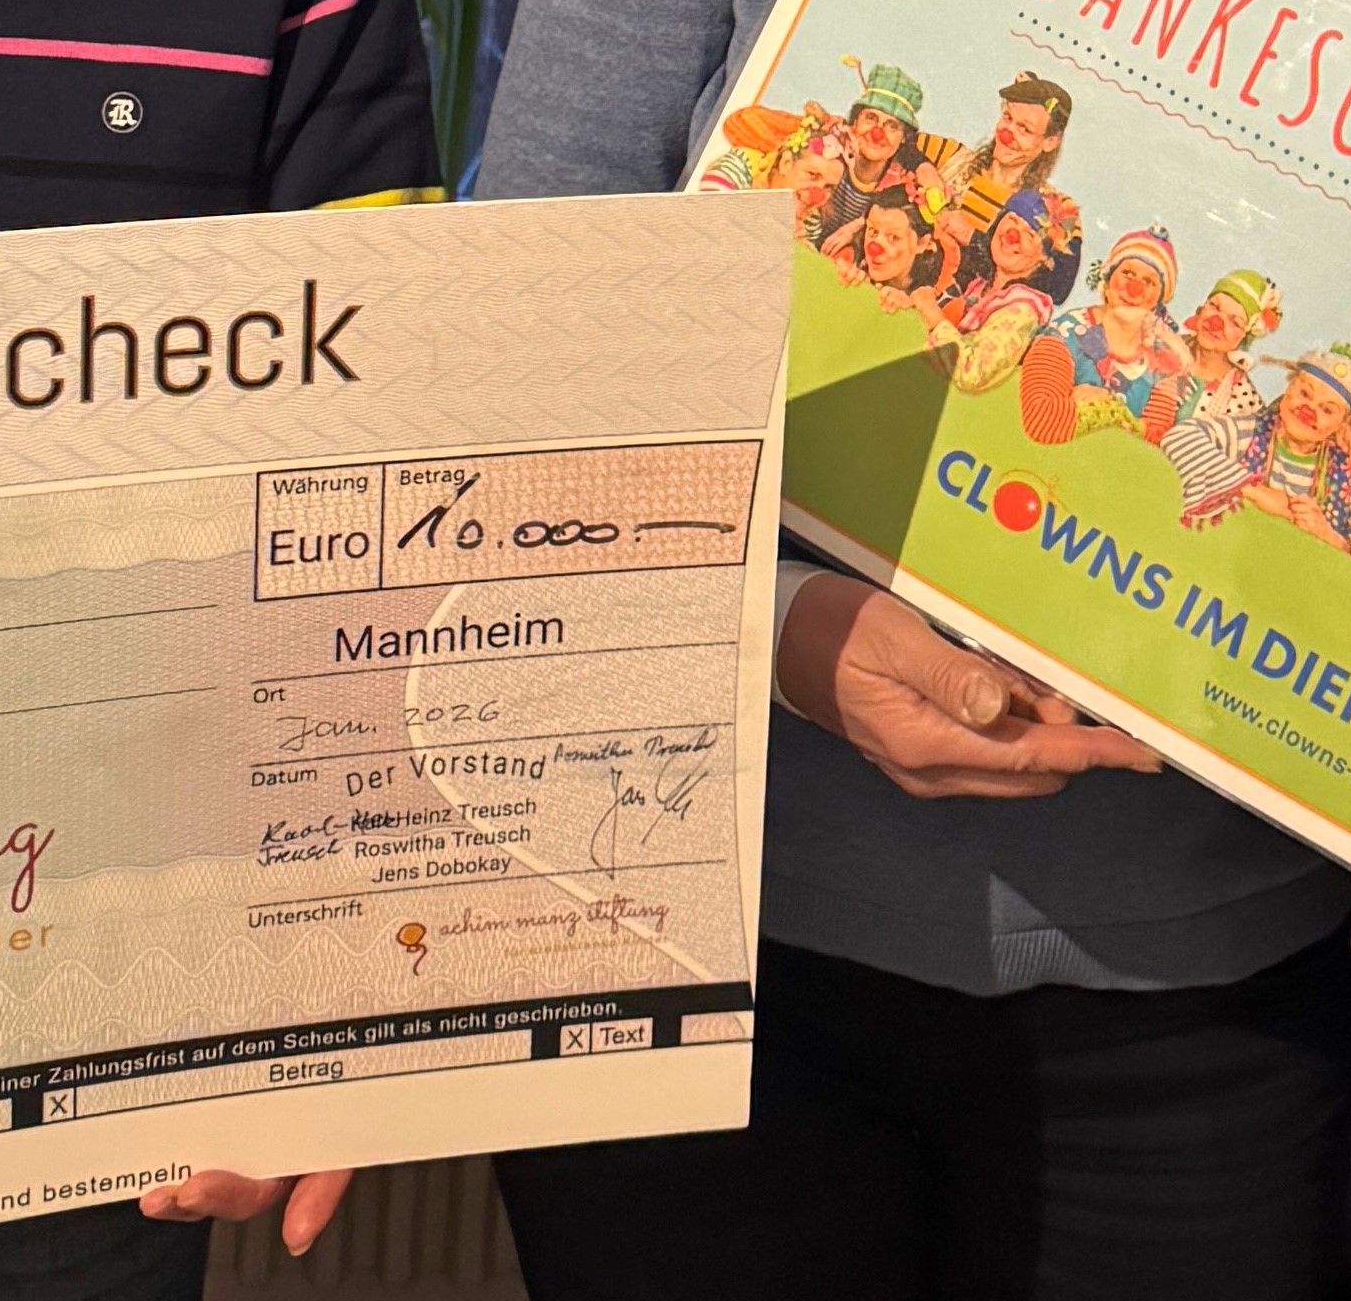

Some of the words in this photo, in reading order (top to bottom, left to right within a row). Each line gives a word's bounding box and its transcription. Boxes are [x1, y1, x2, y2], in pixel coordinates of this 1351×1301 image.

[271, 473, 369, 496] Währung
[398, 466, 466, 487] Betrag
[269, 528, 371, 567] Euro
[936, 449, 1173, 611] CLOWNS
[1173, 584, 1249, 660] IM
[334, 612, 565, 663] Mannheim
[252, 685, 286, 704] Ort
[403, 700, 500, 728] 2026
[250, 765, 318, 788] Datum
[345, 764, 395, 797] Der
[409, 751, 547, 781] Vorstand
[457, 797, 538, 821] Treusch
[354, 834, 446, 859] Roswitha
[451, 825, 531, 849] Treusch
[371, 865, 420, 884] Jens
[425, 855, 512, 878] Dobokay
[247, 901, 364, 929] Unterschrift
[438, 907, 510, 936] achim
[516, 910, 582, 937] manz
[586, 893, 670, 934] stiftung
[47, 1050, 186, 1085] Zahlungsfrist
[191, 1042, 227, 1062] auf
[231, 1038, 277, 1057] dem
[282, 1025, 358, 1050] Scheck
[363, 1020, 396, 1045] gilt
[401, 1014, 433, 1037] als
[438, 1009, 489, 1032] nicht
[493, 1000, 624, 1030] geschrieben.
[599, 1024, 646, 1047] Text
[268, 1059, 345, 1084] Betrag
[42, 1158, 193, 1204] bestempeln
